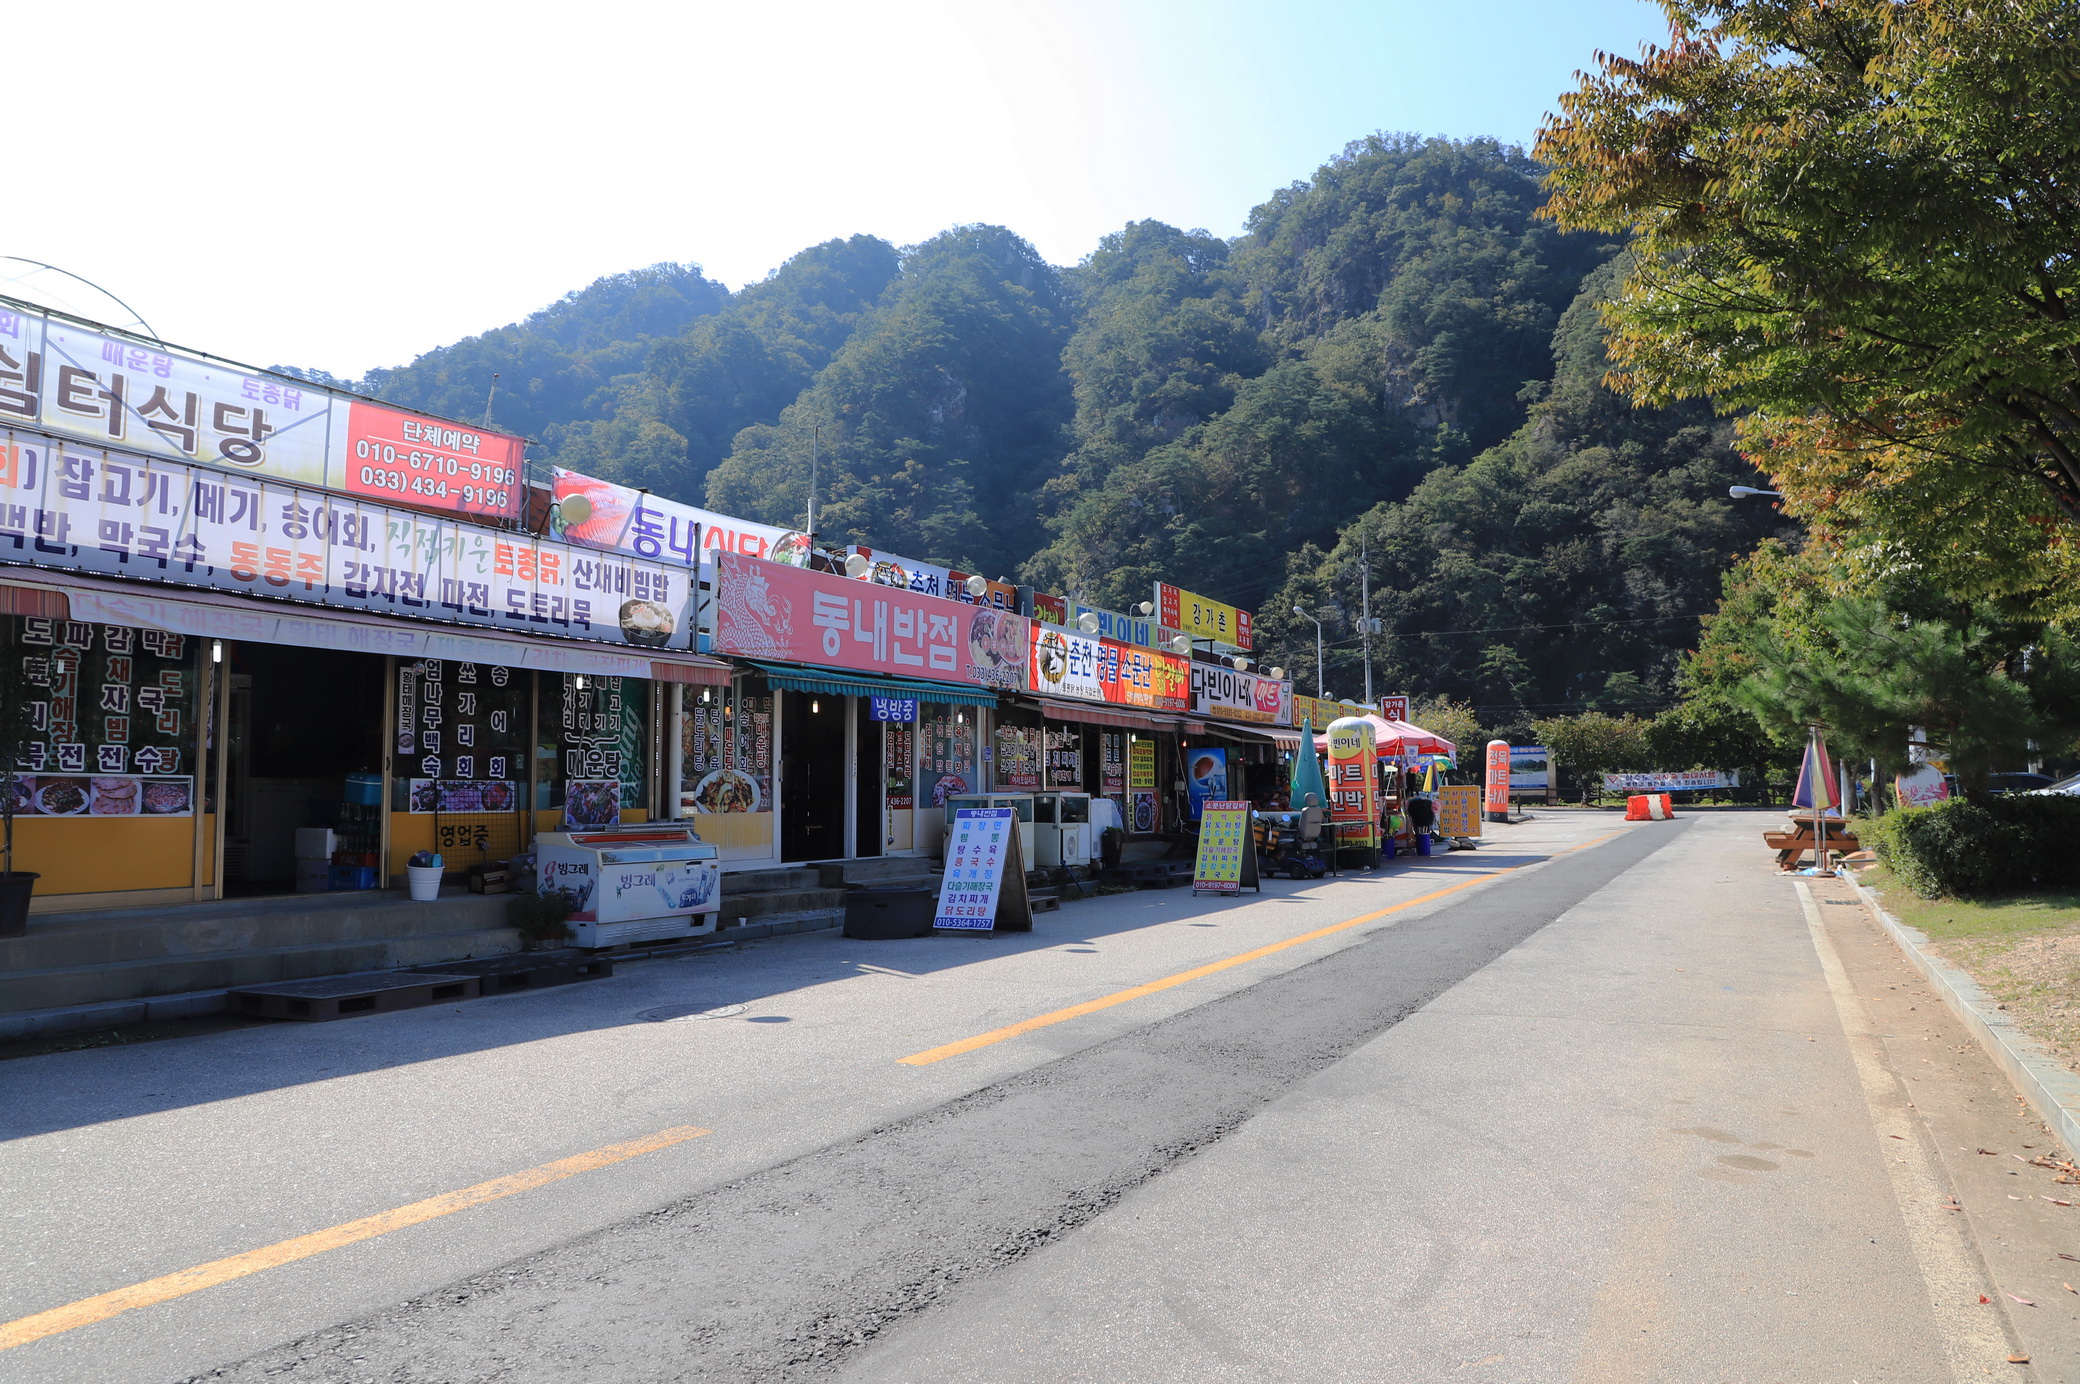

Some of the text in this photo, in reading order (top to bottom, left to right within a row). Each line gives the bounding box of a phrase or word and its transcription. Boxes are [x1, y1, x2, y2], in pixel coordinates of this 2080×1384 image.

[102, 340, 174, 379] 매운탕
[241, 377, 303, 411] 토종닭
[402, 420, 481, 453] 단체예약
[356, 440, 515, 486] 010-6710-9196
[54, 455, 178, 516] 잡고기,
[195, 482, 267, 533] 메기,
[281, 501, 376, 554] 송어회,
[494, 543, 564, 587] 토종닭,
[572, 558, 670, 603] 산채비빔밥
[98, 518, 214, 575] 막국수,
[230, 540, 329, 593] 동동주,
[343, 560, 430, 609] 감자전,
[442, 578, 495, 619] 파전,
[505, 588, 592, 631] 도토리묵
[73, 591, 167, 626] 다슬기
[180, 606, 265, 639] 해장국
[812, 589, 958, 672] 동내반점
[1193, 602, 1226, 633] 강가촌
[1069, 639, 1186, 694] 춘천 명물 소문난 닭갈비
[135, 628, 169, 774] 막국수
[1190, 667, 1252, 707] 다빈이네
[1257, 682, 1278, 709] 마트
[401, 658, 509, 779] 황태해장국 엄나무백숙 쏘가리회 송어회
[875, 697, 914, 721] 냉방중
[1384, 700, 1405, 709] 강가촌
[694, 707, 706, 772] 닭도리탕
[710, 708, 720, 770] 탕수육
[756, 722, 767, 769] 매운탕
[903, 730, 912, 780] 도토리묵
[566, 748, 622, 778] 매운탕
[1489, 750, 1507, 766] 정육
[1330, 764, 1364, 785] 마트
[1488, 769, 1507, 785] 마트
[1331, 790, 1366, 812] 민박
[440, 824, 489, 848] 영업중
[557, 862, 589, 876] 빙그레
[620, 873, 656, 889] 빙그레
[946, 881, 994, 892] 다슬기해장국
[1195, 881, 1237, 889] 010-9197-6006
[936, 918, 991, 928] 010-5364-1757
